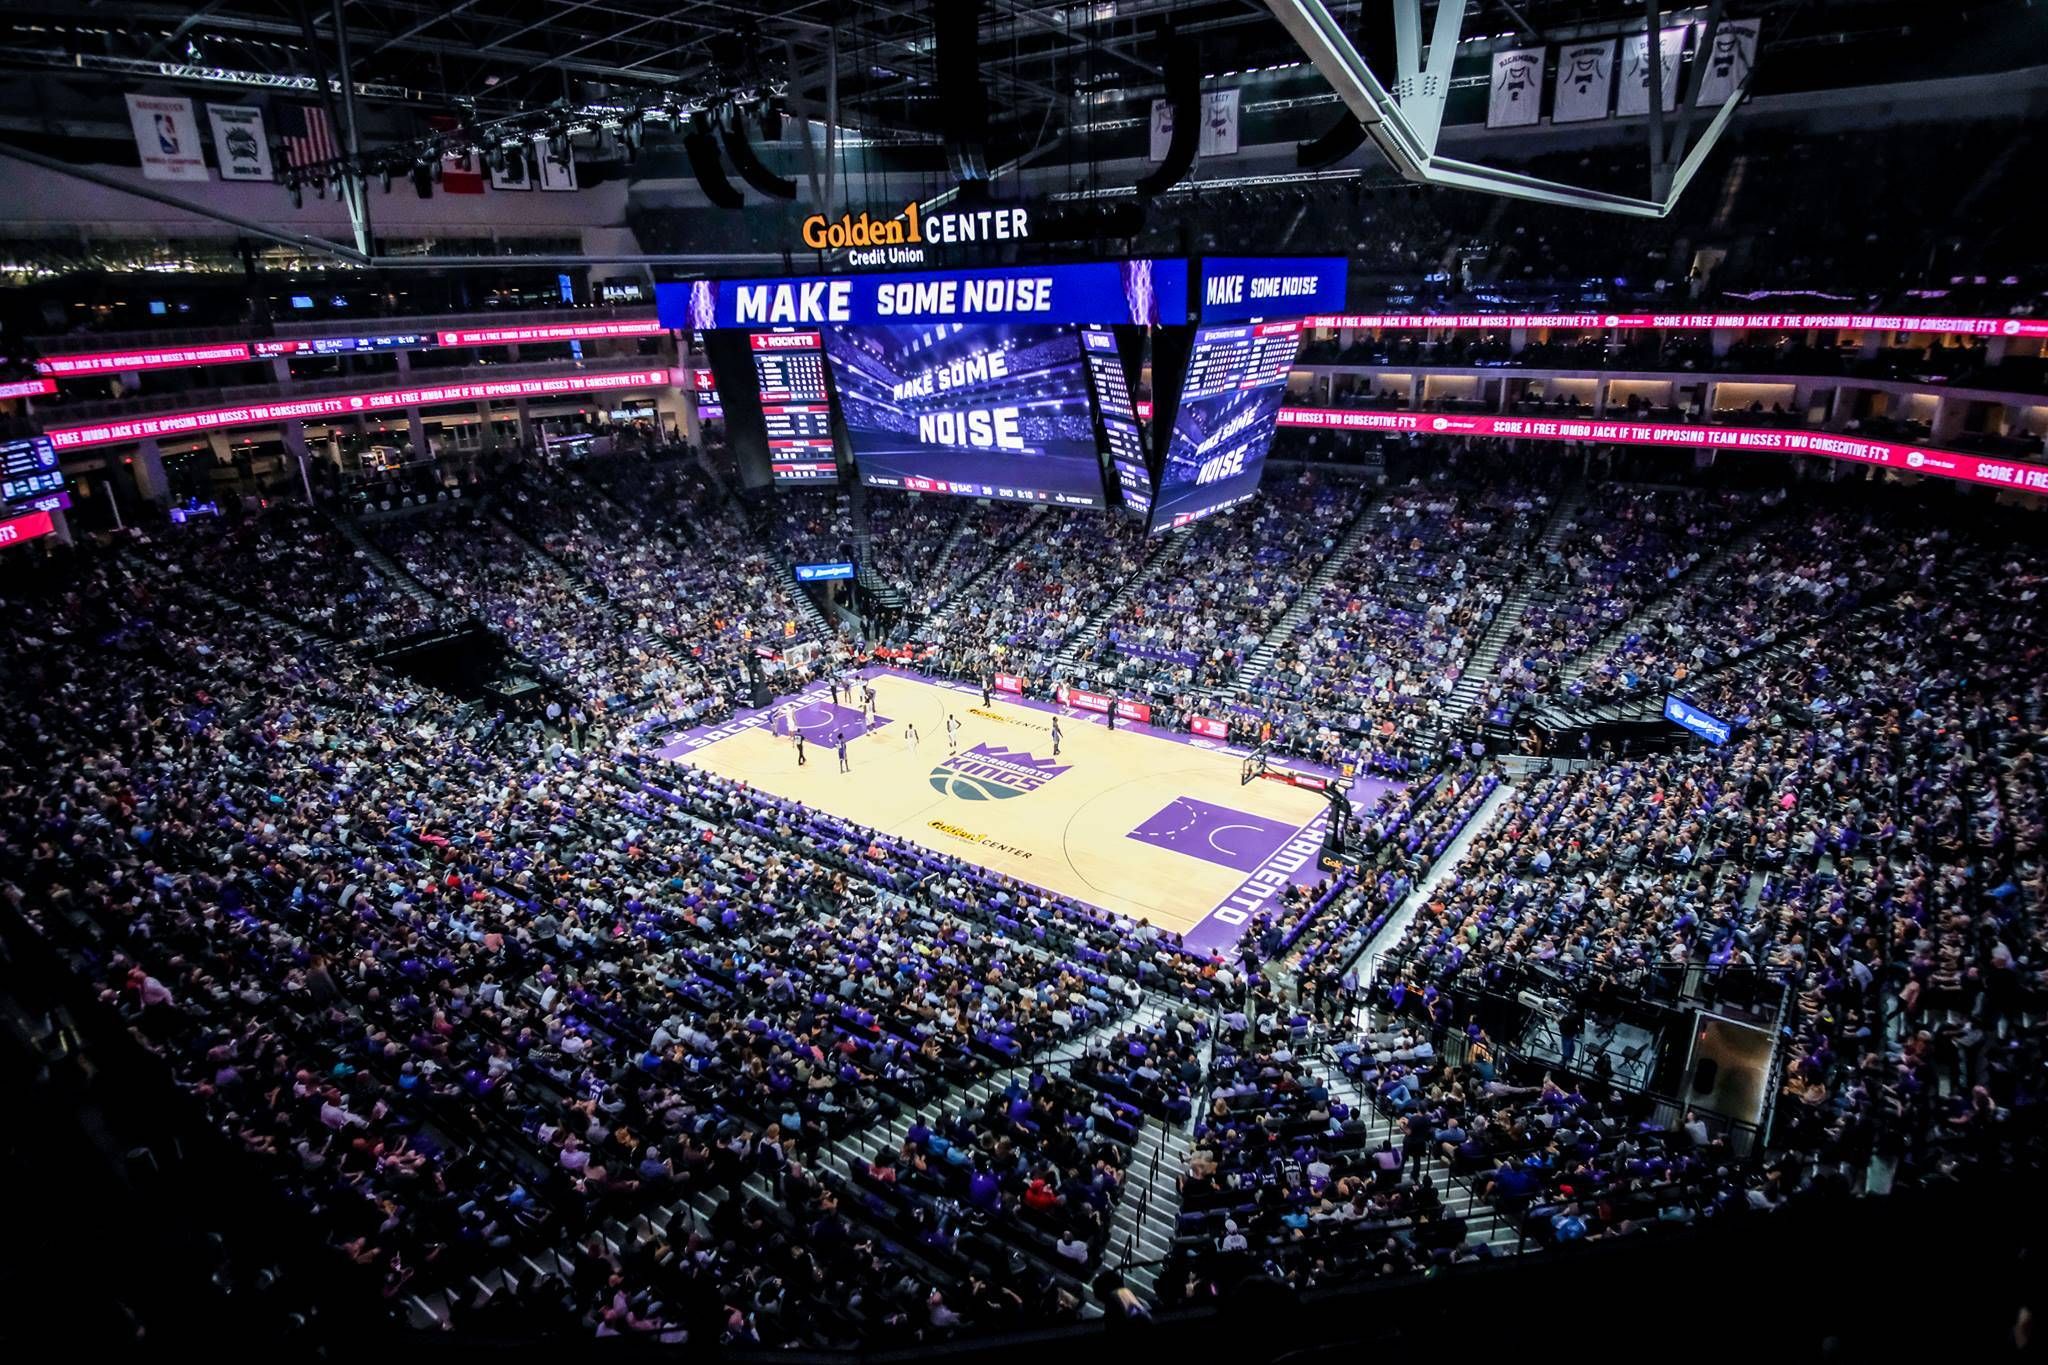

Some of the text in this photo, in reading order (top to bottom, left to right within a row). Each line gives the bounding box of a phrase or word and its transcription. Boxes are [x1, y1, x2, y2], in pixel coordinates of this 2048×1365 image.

[1578, 85, 1587, 94] 4
[925, 208, 1028, 244] CENTER
[849, 247, 924, 265] Credit Union
[735, 278, 1053, 323] MAKE SOME NOISE
[1206, 275, 1318, 305] MAKE SOME NOISE
[1316, 316, 1335, 327] SCORE
[1342, 317, 1358, 327] FREE
[1382, 317, 1399, 326] JACK
[1409, 317, 1423, 326] THE
[1424, 317, 1457, 326] OPPOSING
[1460, 317, 1479, 326] TEAM
[1480, 317, 1507, 326] MISSES
[1509, 317, 1525, 326] TWO
[1527, 317, 1579, 326] CONSECUTIVE
[1653, 317, 1680, 326] SCORE
[1682, 317, 1689, 326] A
[1691, 317, 1712, 326] FREE
[1714, 317, 1743, 326] JUMBO
[1746, 317, 1769, 326] JACK
[1771, 316, 1780, 326] IF
[1783, 317, 1800, 326] THE
[1803, 317, 1849, 326] OPPOSING
[1851, 317, 1873, 327] TEAM
[1874, 318, 1901, 328] MISSES
[1902, 318, 1920, 329] TWO
[1920, 319, 1976, 332] CONSECUTIVE
[1977, 320, 1997, 332] FT'S
[327, 339, 342, 348] SAC
[768, 336, 814, 347] ROCKETS
[893, 349, 1008, 400] MAKE SOME
[370, 395, 393, 406] SCORE
[402, 393, 420, 402] FREE
[421, 390, 444, 400] JUMBO
[445, 389, 461, 398] JACK
[470, 386, 484, 395] THE
[486, 384, 520, 394] OPPOSING
[522, 382, 542, 392] TEAM
[543, 380, 569, 390] MISSES
[570, 379, 585, 388] TWO
[586, 376, 630, 387] CONSECUTIVE
[56, 432, 80, 445] FREE
[82, 428, 110, 441] JUMBO
[112, 426, 133, 437] JACK
[133, 424, 142, 434] IF
[143, 422, 159, 432] THE
[160, 417, 197, 430] OPPOSING
[198, 414, 218, 425] TEAM
[218, 410, 249, 422] MISSES
[251, 408, 268, 418] TWO
[270, 403, 323, 416] CONSECUTIVE
[919, 406, 1024, 449] NOISE
[1220, 406, 1257, 441] SOME
[1277, 411, 1416, 427] EAM MISSES TWO CONSECUTIVE FT'S
[1493, 422, 1890, 460] SCORE A FREE JUMBO JACK IF THE OPPOSING TEAM MISSES TWO CONSECUTIVE FT'S
[1196, 444, 1248, 485] NOISE
[1976, 464, 2014, 482] SCORE
[2014, 469, 2024, 484] A
[940, 757, 1047, 791] KINGS
[962, 751, 1054, 780] SACRAMENTO
[981, 839, 1033, 860] CENTER
